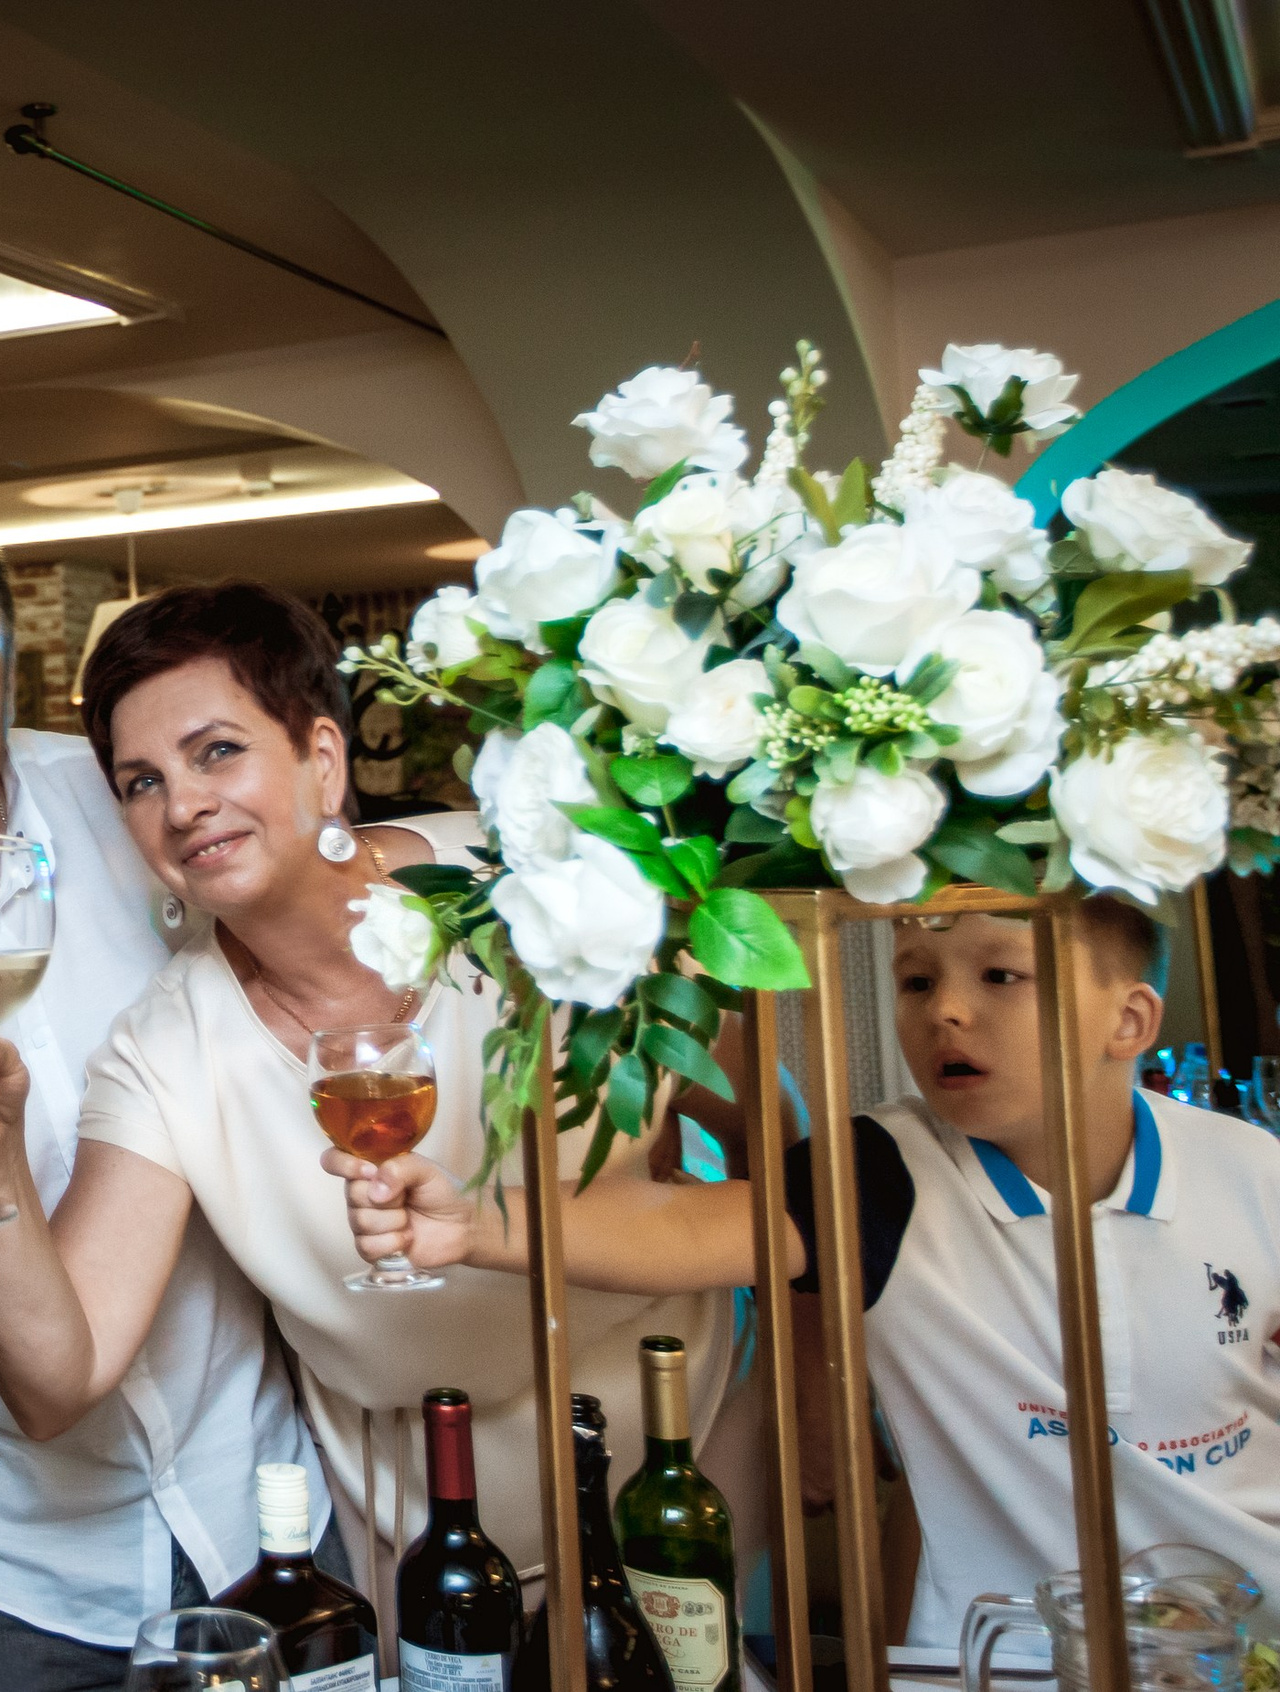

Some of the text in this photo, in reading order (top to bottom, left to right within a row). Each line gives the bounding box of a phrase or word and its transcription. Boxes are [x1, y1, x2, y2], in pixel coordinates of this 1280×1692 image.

[1218, 1328, 1249, 1345] USPA
[1018, 1402, 1069, 1419] UNITE
[1206, 1428, 1251, 1465] CUP
[679, 1627, 697, 1637] DE
